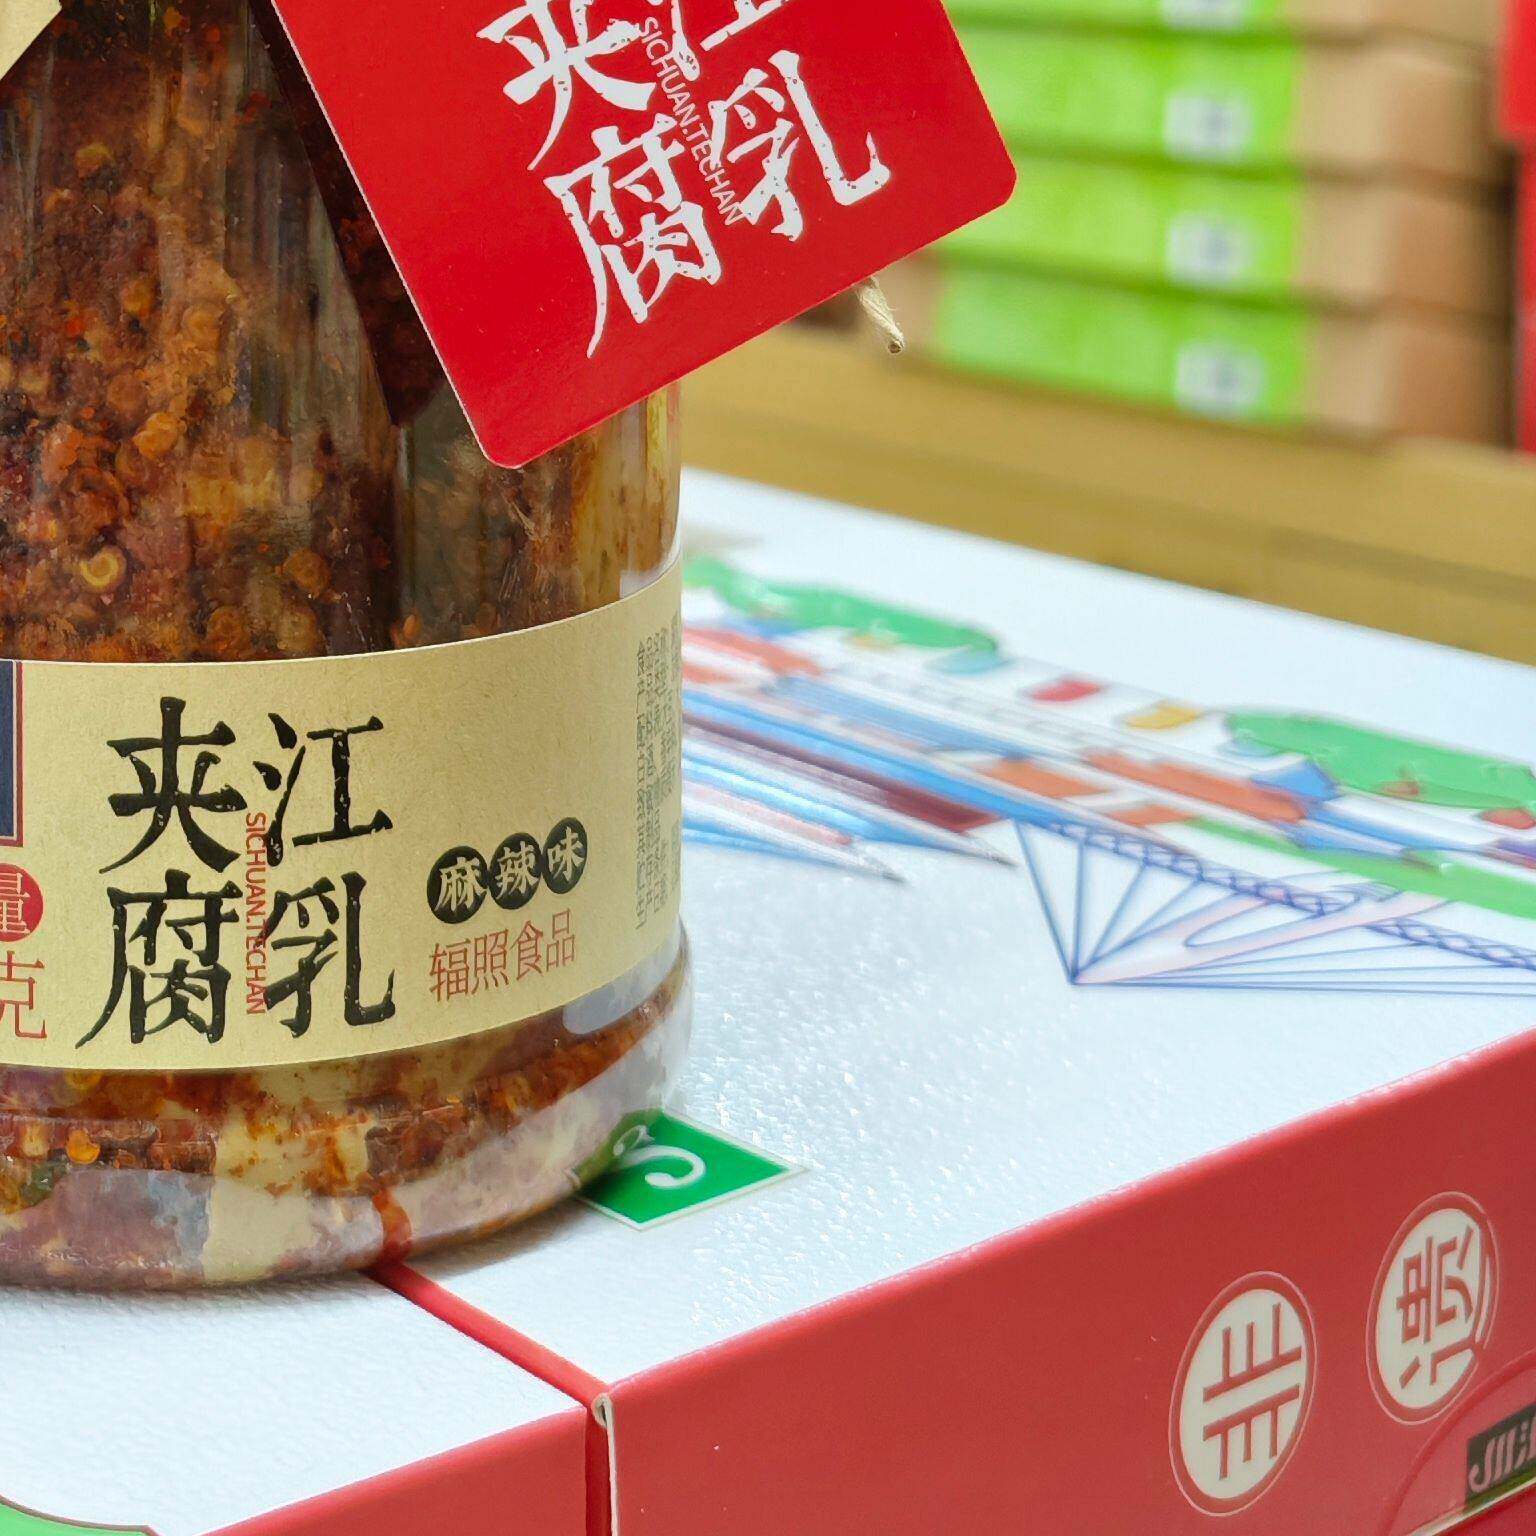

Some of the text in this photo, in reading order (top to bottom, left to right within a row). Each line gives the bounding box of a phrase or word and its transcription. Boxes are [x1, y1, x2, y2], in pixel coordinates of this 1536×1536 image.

[543, 50, 891, 358] 腐乳
[98, 696, 394, 875] 夹江
[435, 825, 585, 913] 麻辣味
[74, 868, 397, 1050] 腐乳
[428, 907, 577, 1004] 辐照食品
